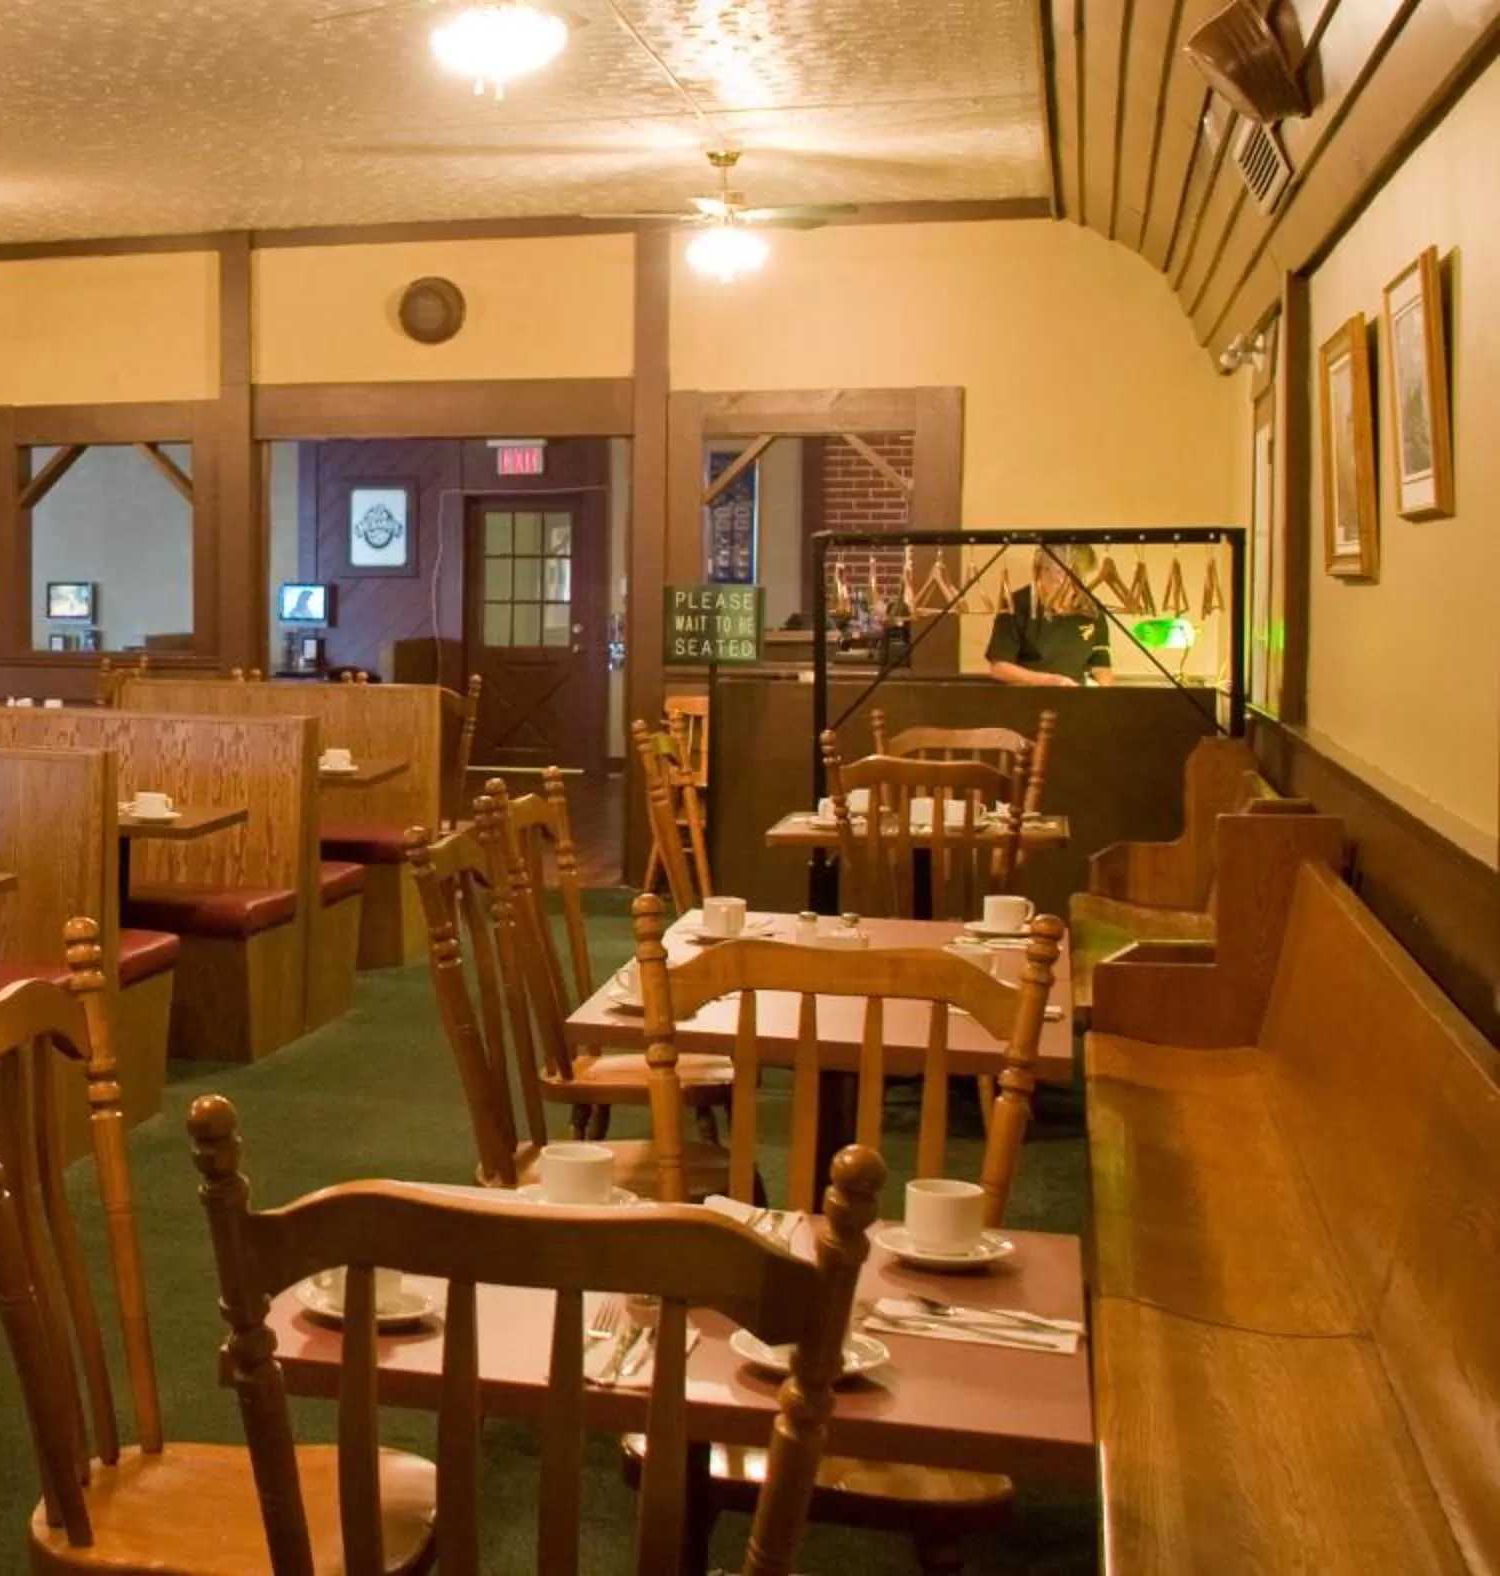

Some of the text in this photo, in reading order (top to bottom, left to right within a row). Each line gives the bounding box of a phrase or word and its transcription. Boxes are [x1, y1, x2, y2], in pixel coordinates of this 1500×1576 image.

[501, 450, 537, 473] EXIT
[675, 591, 753, 611] PLEASE
[675, 615, 708, 633] WAIT
[715, 615, 732, 634] TO
[675, 637, 754, 657] SEATED
